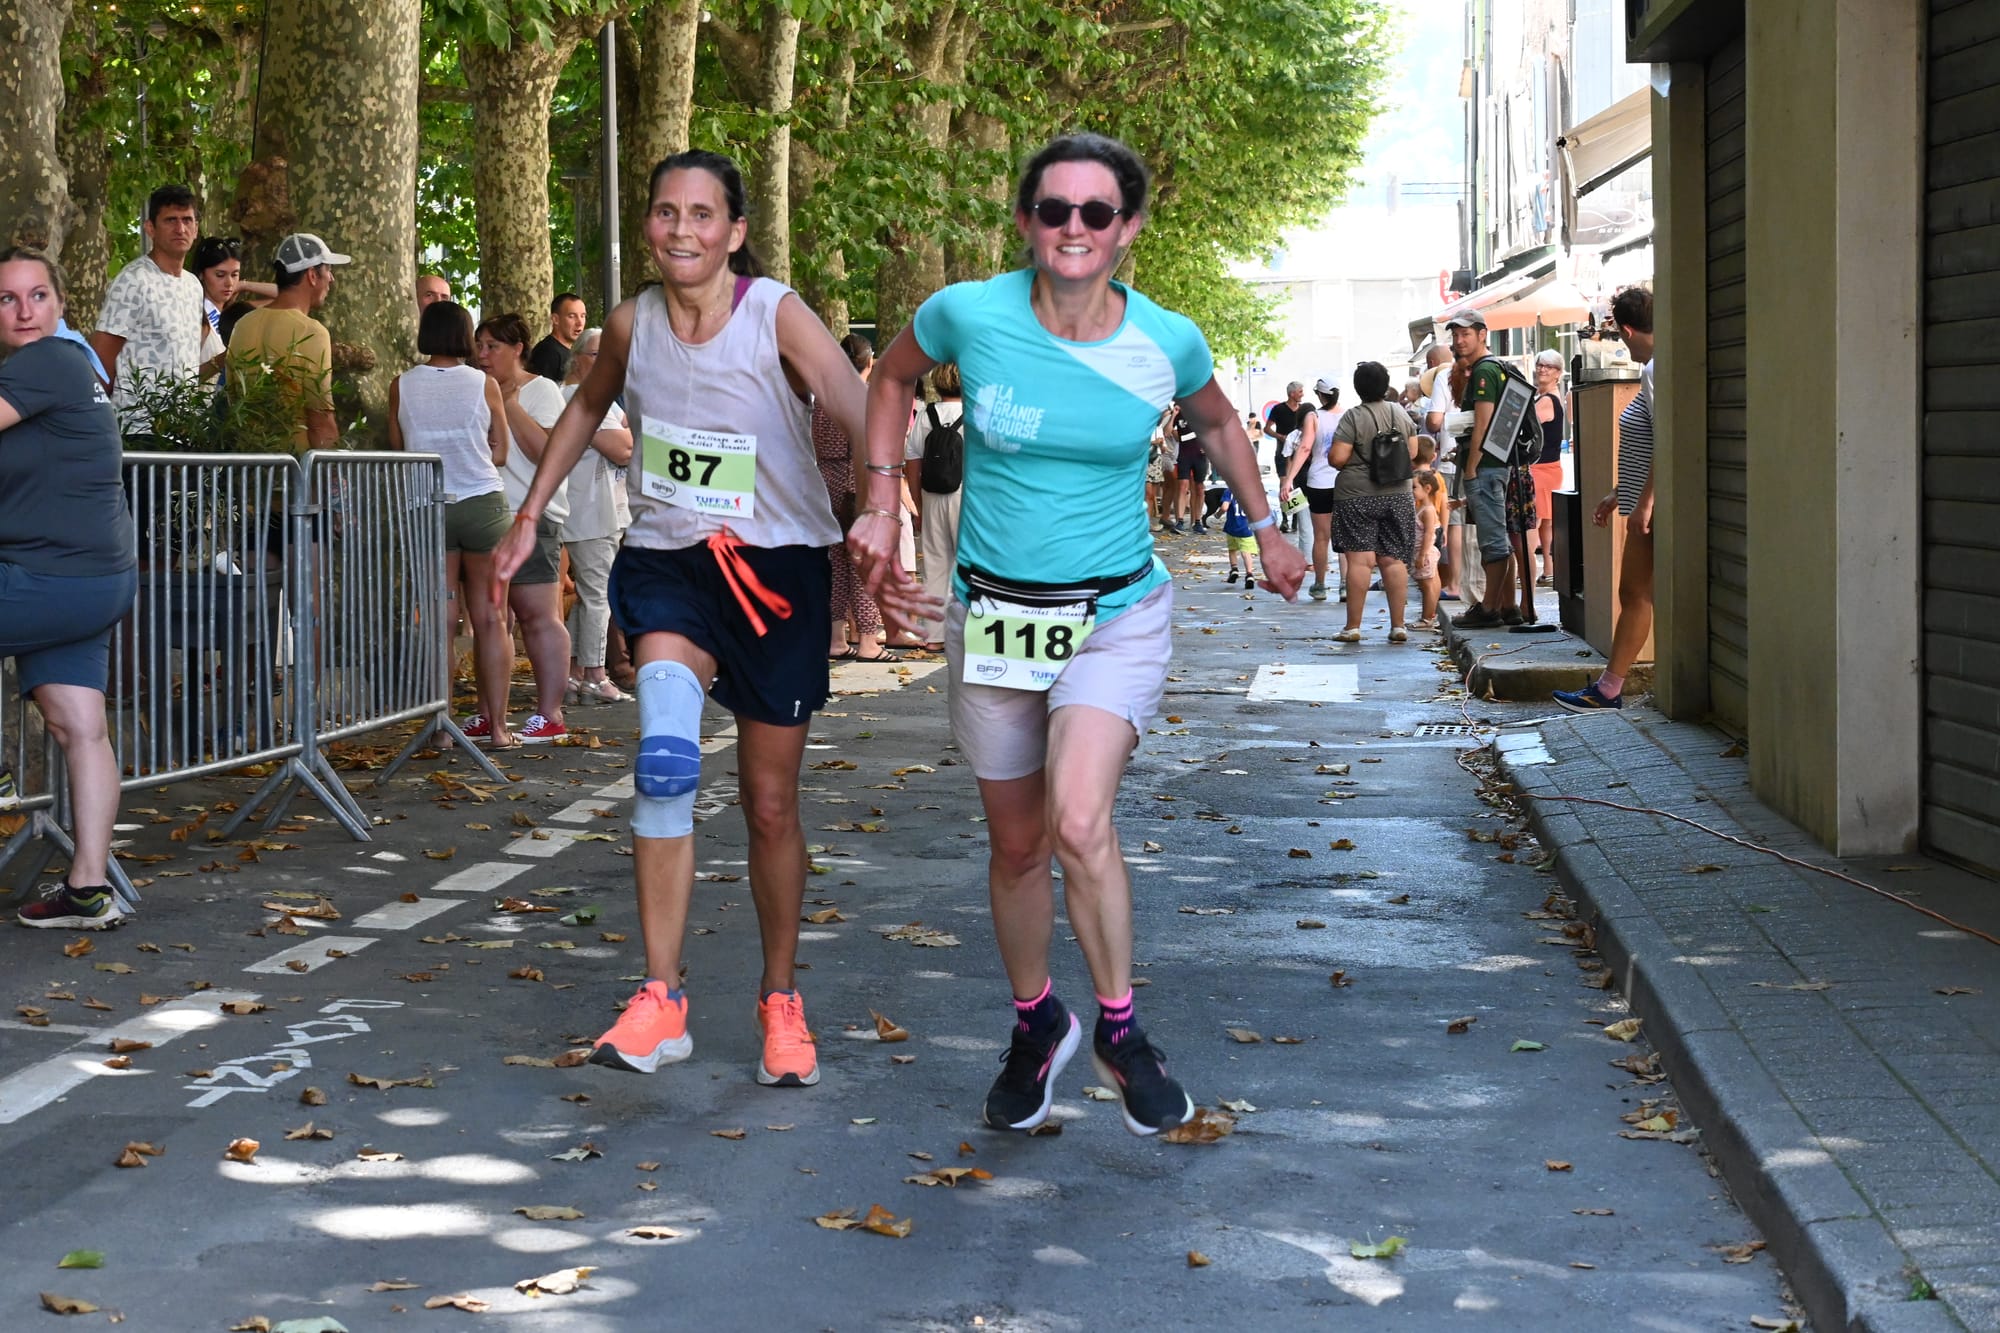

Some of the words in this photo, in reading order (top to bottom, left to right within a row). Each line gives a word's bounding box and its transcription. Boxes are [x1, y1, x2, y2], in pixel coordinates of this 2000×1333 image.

[997, 384, 1014, 402] LA
[992, 399, 1045, 425] GRANDE
[989, 415, 1041, 440] COURSE
[668, 448, 722, 487] 87
[1287, 497, 1300, 510] 37
[984, 619, 1073, 661] 118
[976, 664, 1003, 673] BFP
[1029, 670, 1057, 680] TUFF
